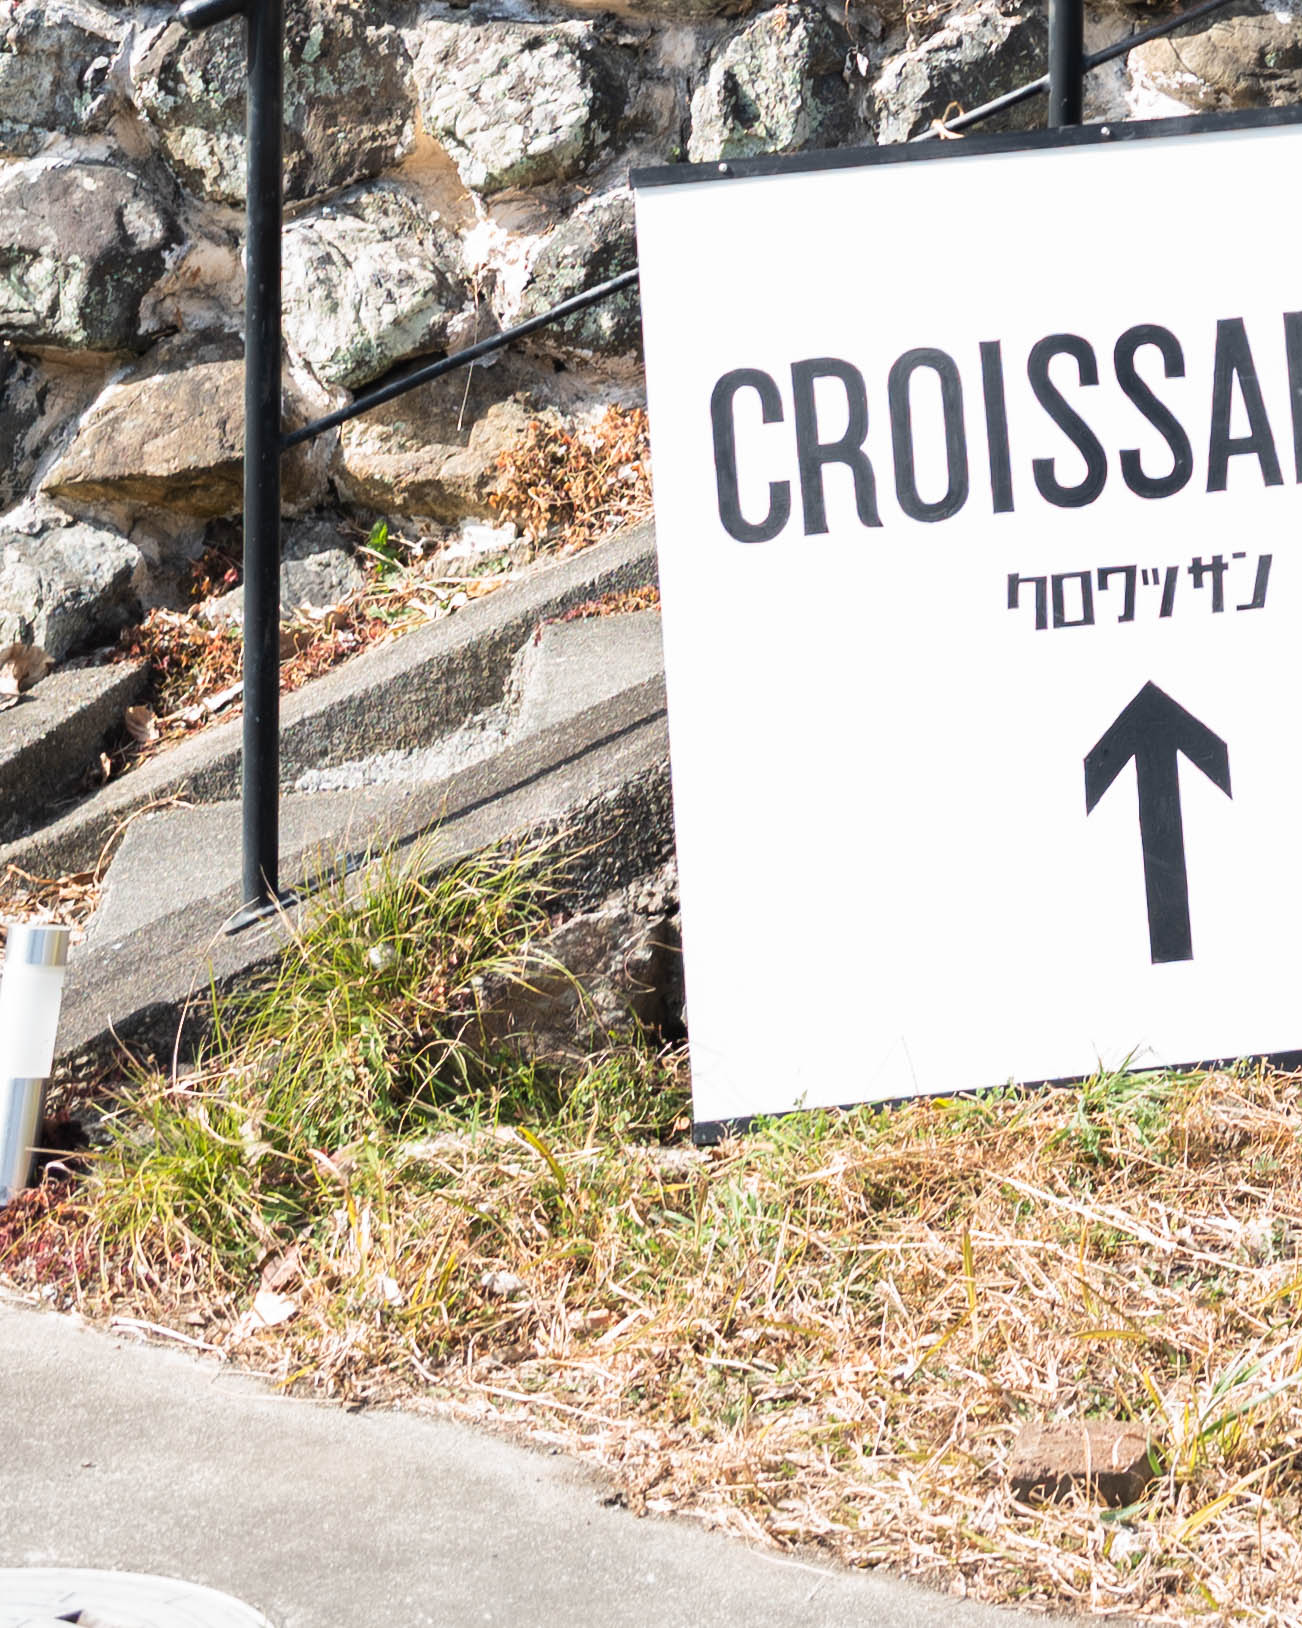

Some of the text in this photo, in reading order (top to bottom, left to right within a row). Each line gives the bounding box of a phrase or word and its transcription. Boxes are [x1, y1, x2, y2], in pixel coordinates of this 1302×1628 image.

[1006, 551, 1273, 631] クロワッサン
